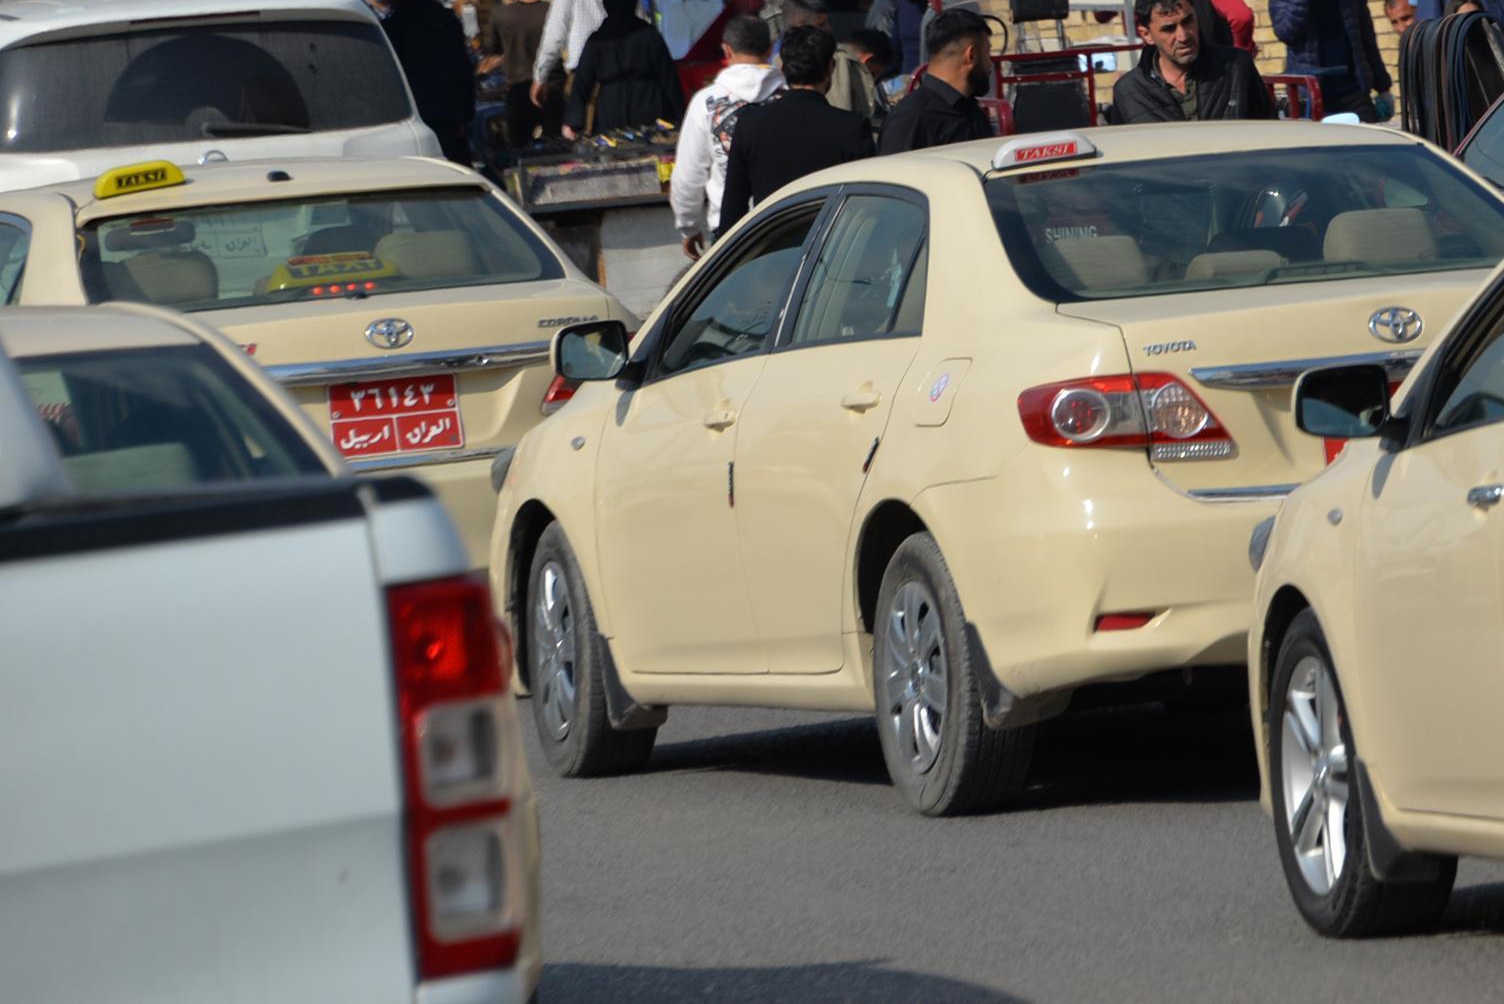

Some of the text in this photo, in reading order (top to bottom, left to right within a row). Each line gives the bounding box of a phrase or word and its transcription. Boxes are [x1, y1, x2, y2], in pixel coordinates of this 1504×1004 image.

[1020, 143, 1070, 161] TAKSI
[1143, 340, 1197, 357] TOYOTA
[351, 383, 434, 412] ٣٦١٤٣
